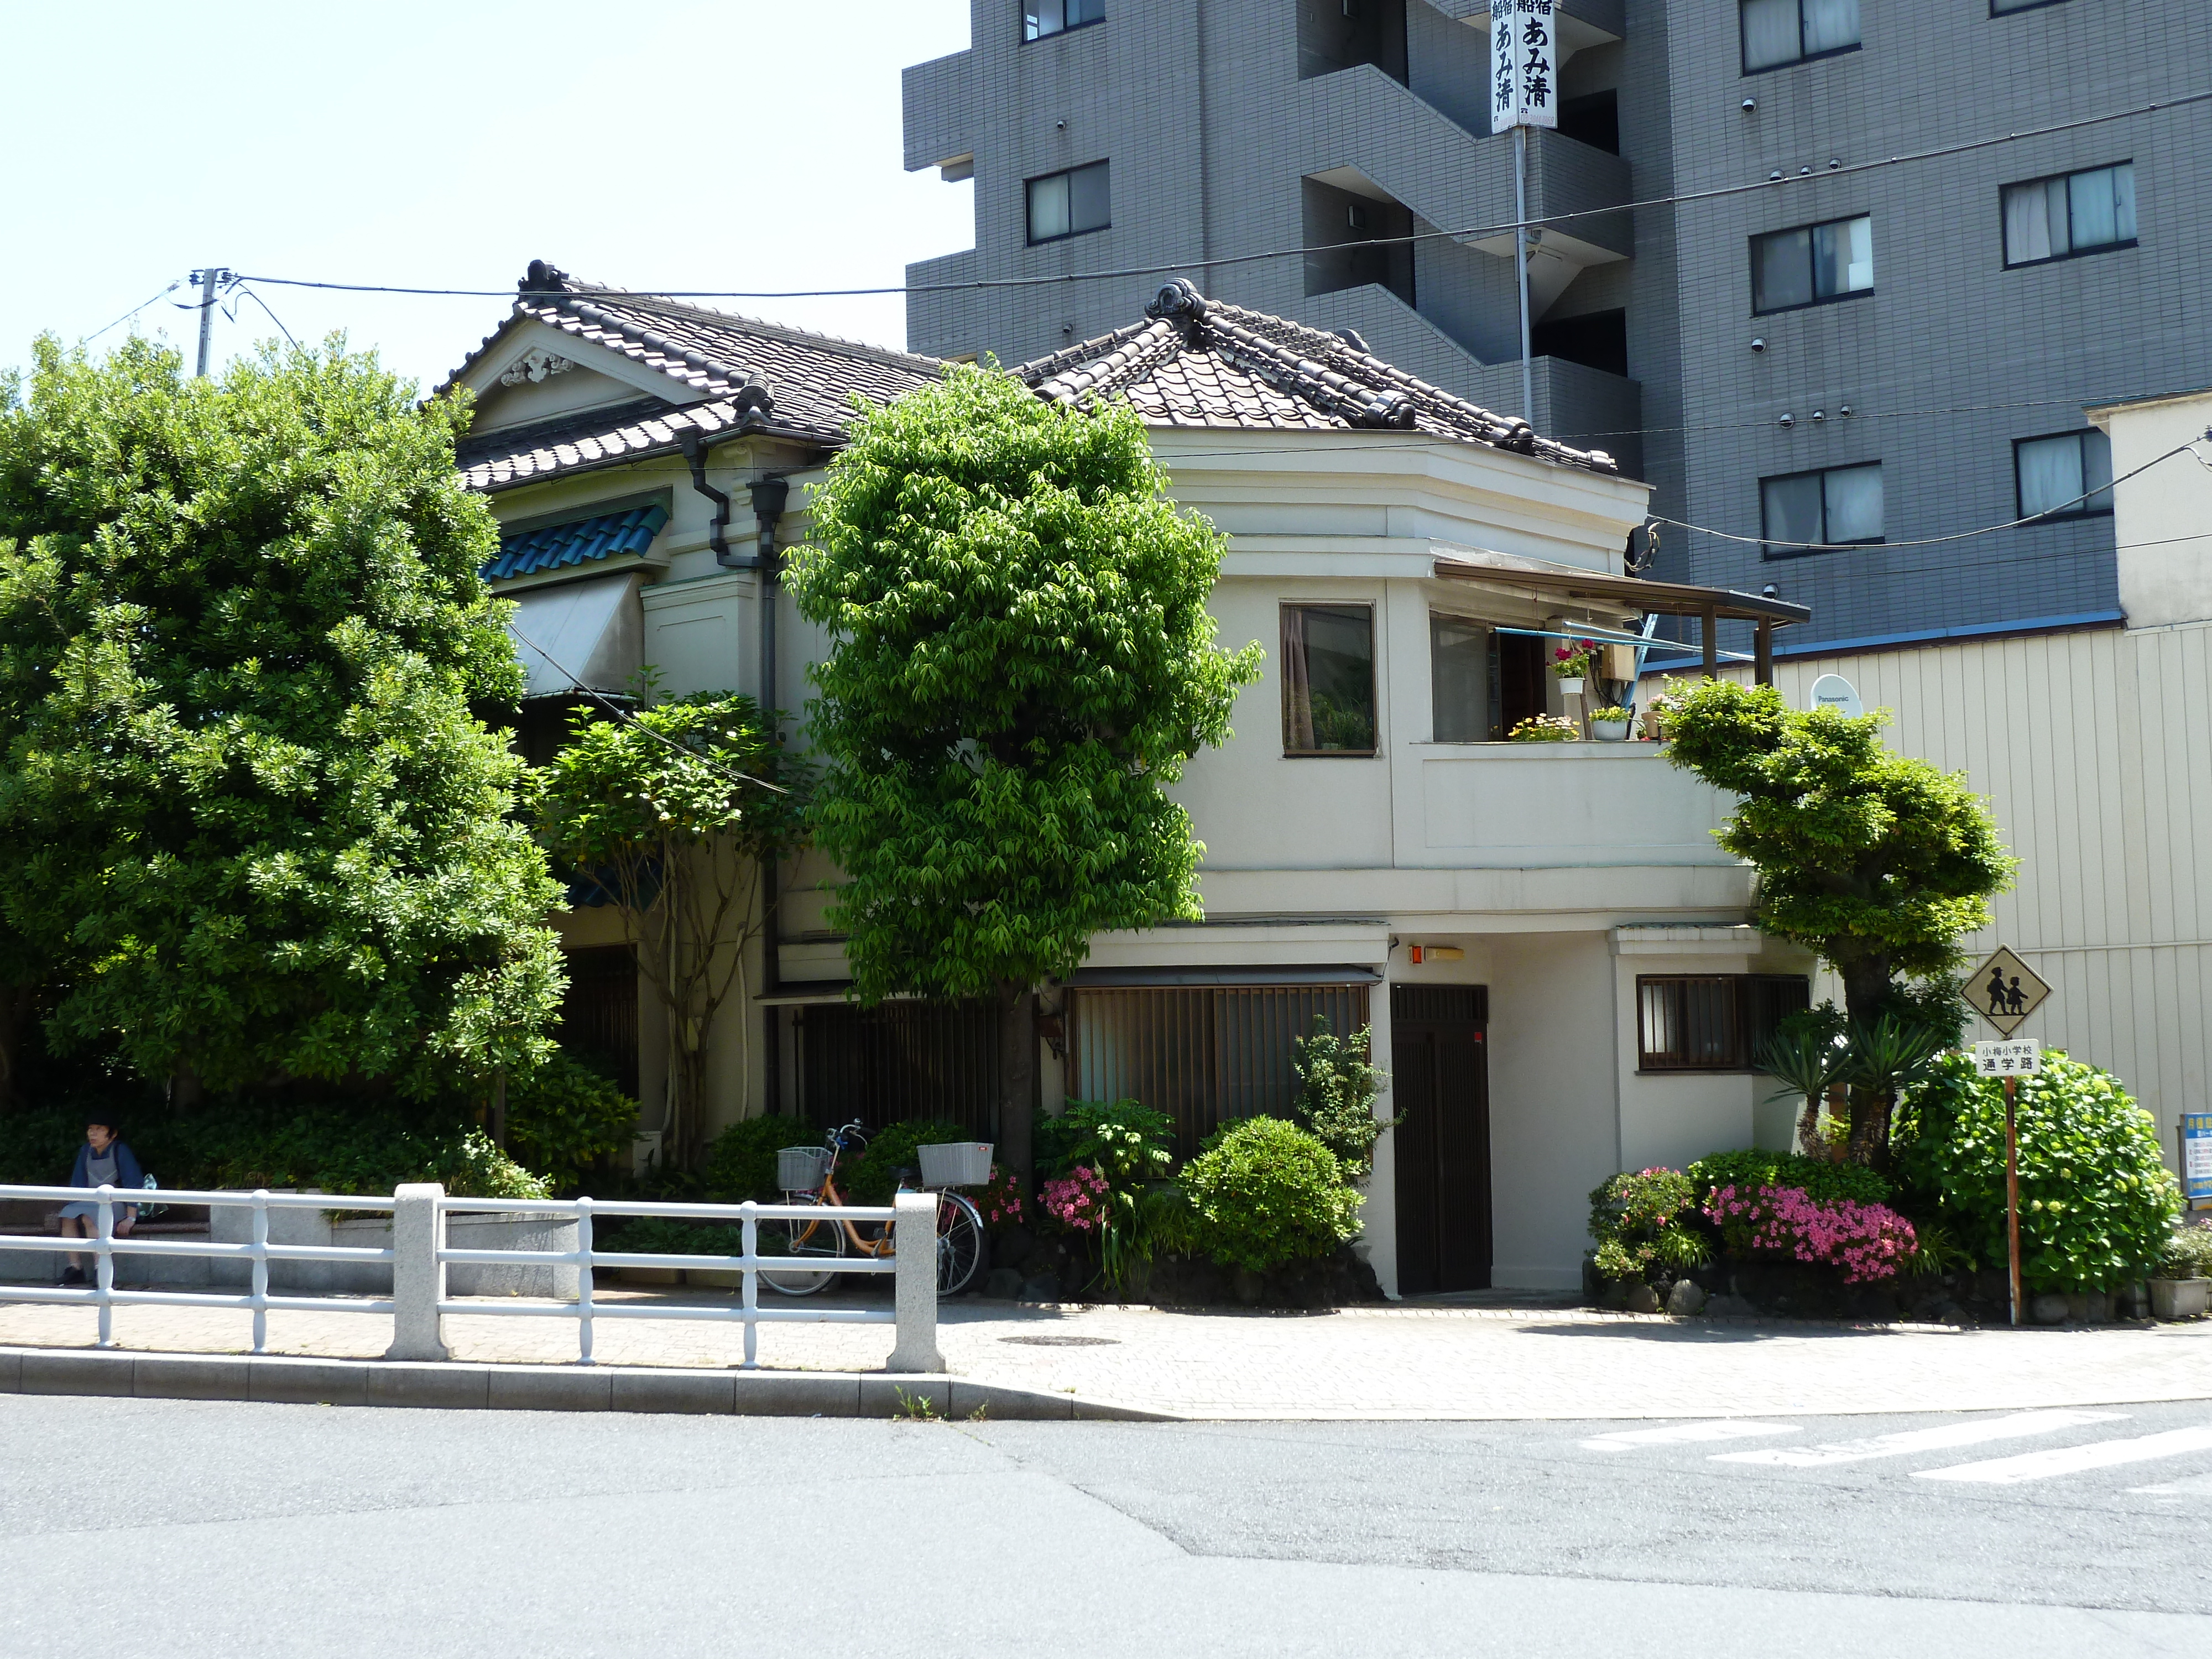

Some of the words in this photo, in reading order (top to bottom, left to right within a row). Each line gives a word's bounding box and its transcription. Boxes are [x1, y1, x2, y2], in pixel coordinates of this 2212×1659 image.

[1496, 22, 1513, 112] あみ清
[1522, 17, 1551, 108] あみ清
[1983, 1045, 2032, 1057] 小梅小学校
[1983, 1057, 2033, 1071] 通学路
